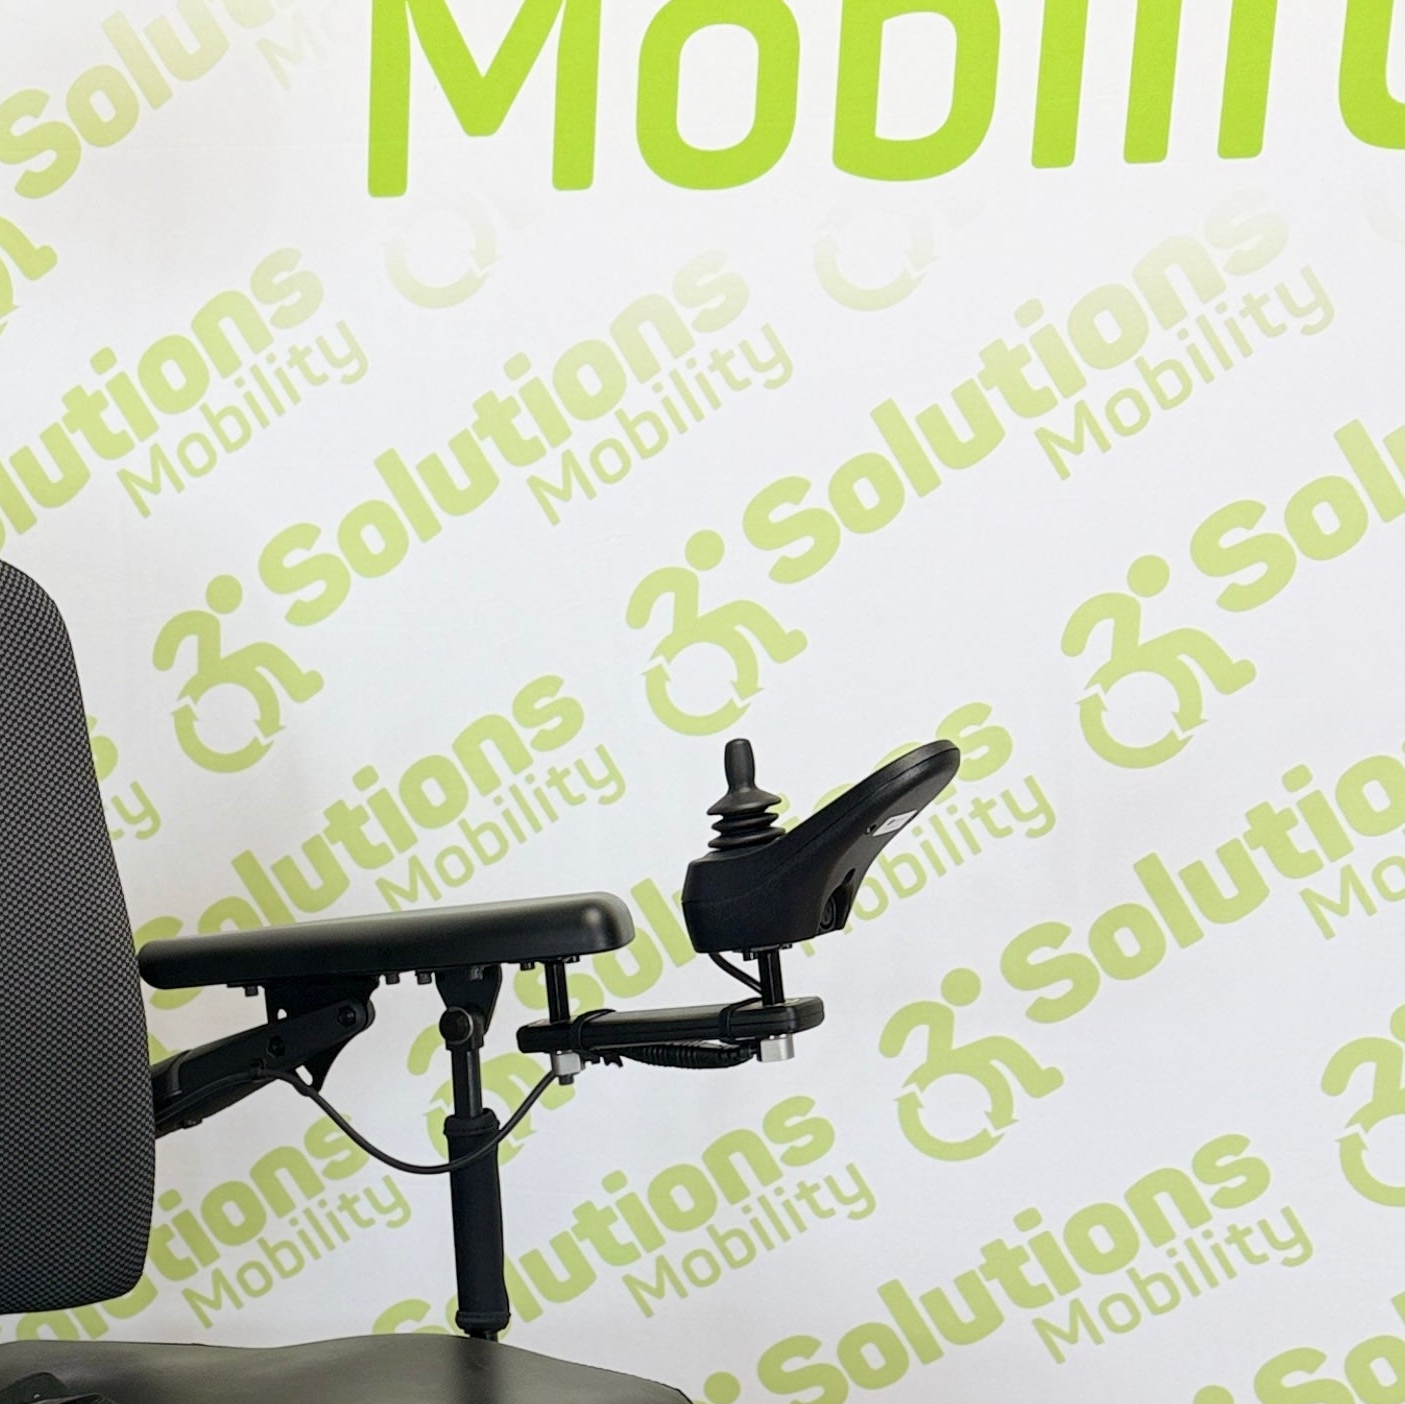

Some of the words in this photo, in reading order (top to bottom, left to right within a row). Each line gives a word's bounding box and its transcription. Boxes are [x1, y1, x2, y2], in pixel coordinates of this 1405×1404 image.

[115, 320, 369, 520] Mobility
[258, 250, 749, 628] Solutions
[526, 323, 794, 526] Mobility
[742, 188, 1290, 585] Solutions
[1034, 265, 1336, 481] Mobility
[375, 744, 626, 912] Mobility
[1000, 740, 1405, 1024] Solutio
[182, 1174, 412, 1330] Mobility
[622, 1162, 876, 1318] Mobility
[1031, 1205, 1314, 1366] Mobility
